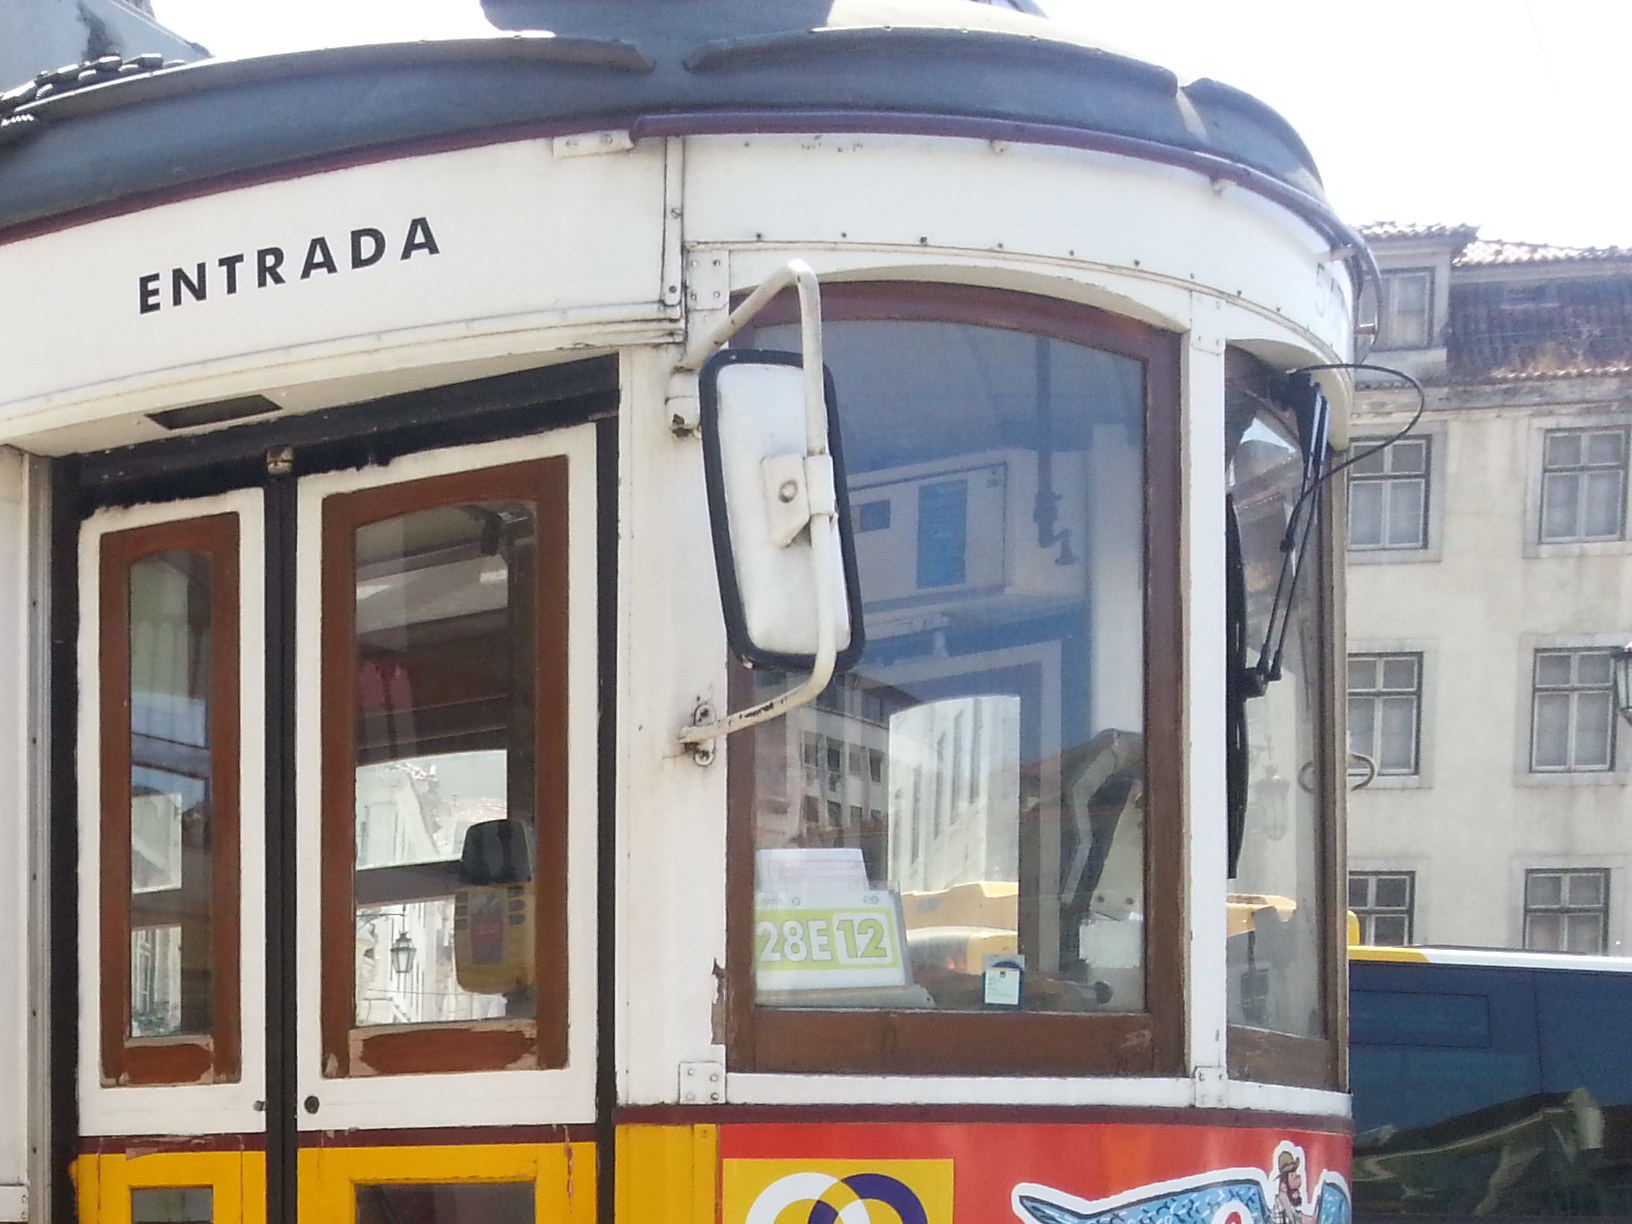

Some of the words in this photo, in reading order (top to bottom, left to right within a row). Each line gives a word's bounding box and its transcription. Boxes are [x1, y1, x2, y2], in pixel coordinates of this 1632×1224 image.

[138, 216, 441, 315] ENTRADA
[756, 919, 833, 963] 28E
[836, 918, 888, 959] 12
